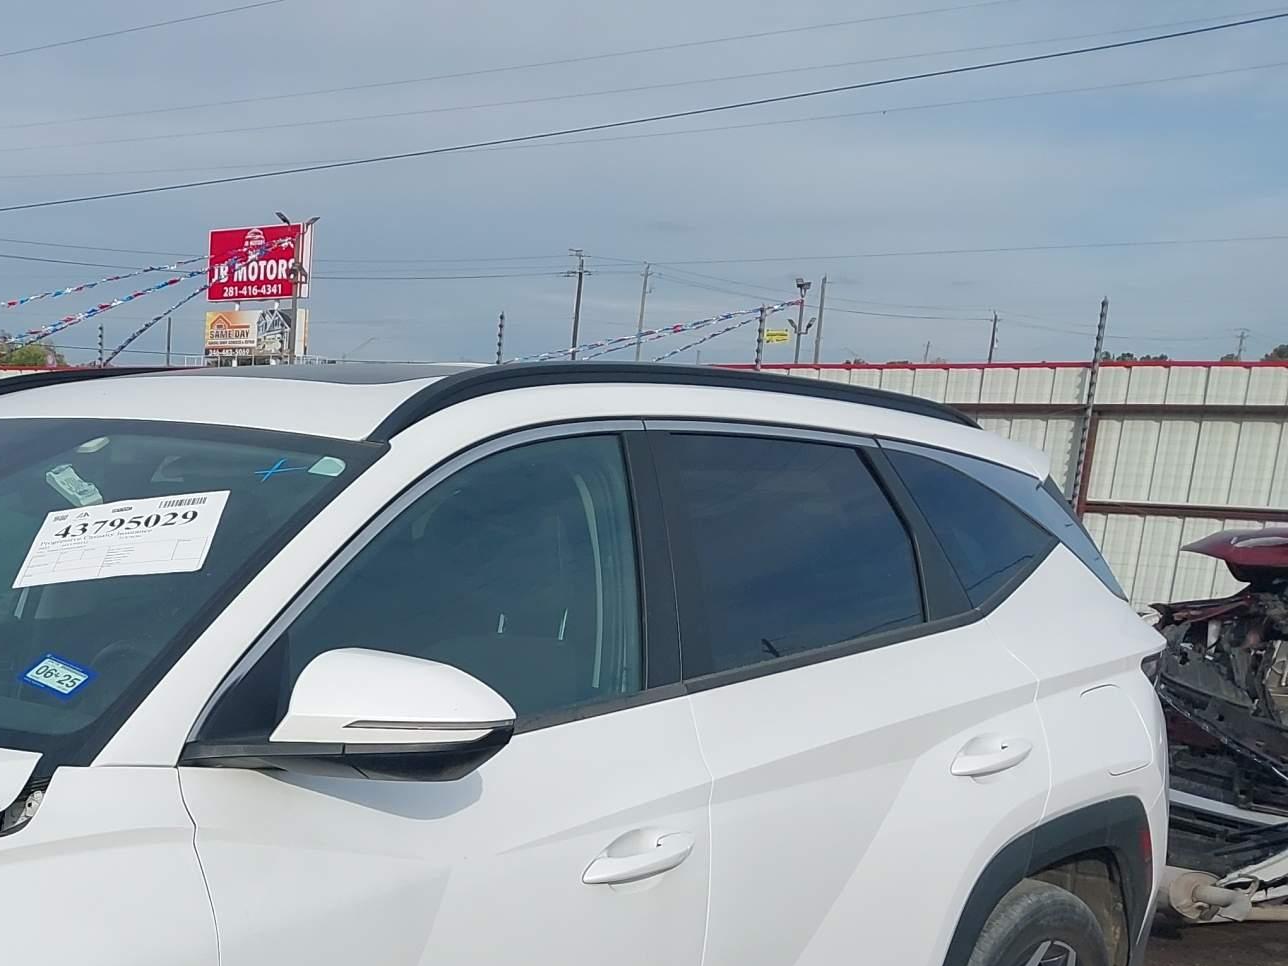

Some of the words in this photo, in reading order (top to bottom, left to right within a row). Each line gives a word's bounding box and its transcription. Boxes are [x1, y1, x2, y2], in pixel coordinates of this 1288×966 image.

[223, 284, 282, 297] 281-416-4341
[209, 329, 232, 339] SAME
[234, 329, 250, 339] DAY
[54, 510, 198, 538] 43795029
[35, 665, 58, 679] 06
[56, 674, 81, 688] 25
